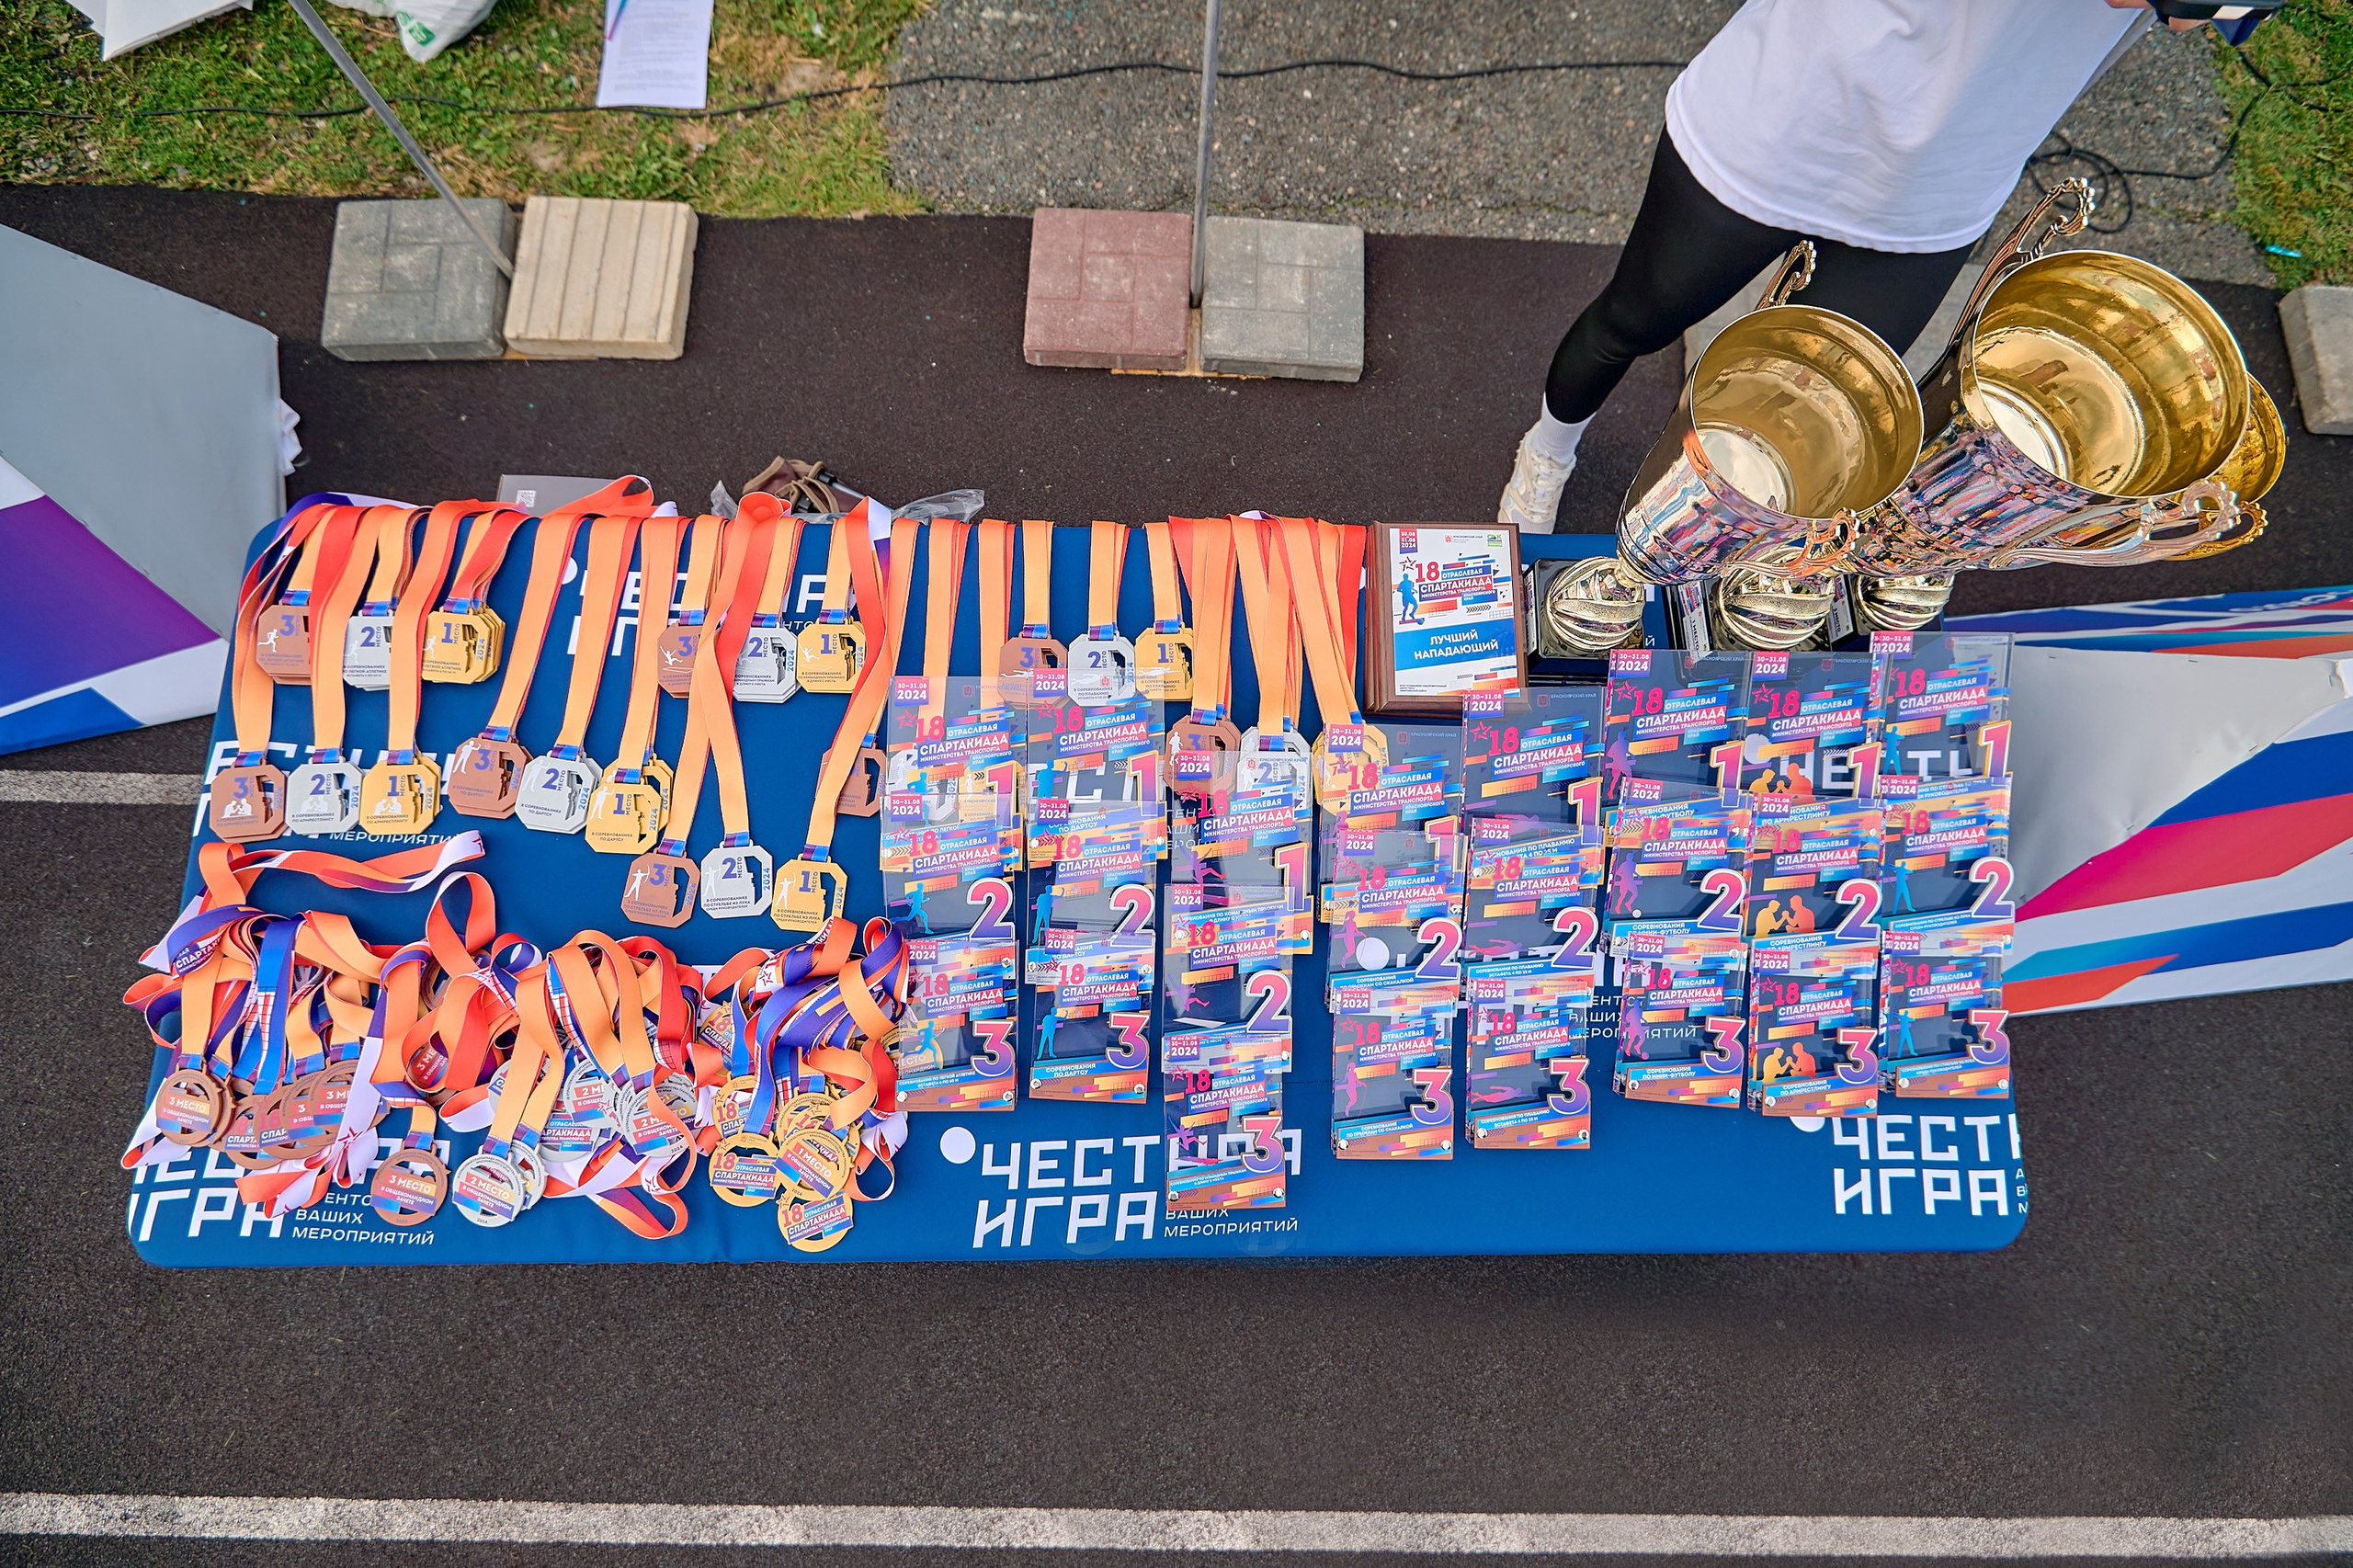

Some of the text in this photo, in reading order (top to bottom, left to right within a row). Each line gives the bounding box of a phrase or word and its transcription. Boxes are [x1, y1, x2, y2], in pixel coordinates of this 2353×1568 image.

[1415, 562, 1483, 583] 18 ОТРАСЛЕВАЯ
[1421, 576, 1492, 593] СПАРТАКИАДА
[442, 623, 451, 642] 1
[1430, 629, 1478, 645] ЛУЧШИЙ
[1414, 639, 1498, 660] НАПАДАЮЩИЙ
[1881, 642, 1910, 653] 2024
[1618, 661, 1648, 671] 2024
[1756, 664, 1786, 674] 2024
[1035, 681, 1064, 690] 2024
[1895, 669, 1976, 697] 18 ОТРАСЛЕВАЯ
[897, 690, 926, 699] 2024
[1631, 687, 1716, 716] 18 ОТРАСЛЕВАЯ
[1768, 690, 1852, 718] 18 ОТРАСЛЕВАЯ
[1900, 687, 1985, 709] СПАРТАКИАДА
[1472, 701, 1501, 711] 2024
[915, 716, 998, 743] 18 ОТРАСЛЕВАЯ
[1053, 706, 1135, 733] 18 ОТРАСЛЕВАЯ
[1636, 708, 1725, 729] СПАРТАКИАДА
[1772, 710, 1860, 731] СПАРТАКИАДА
[920, 733, 1008, 755] СПАРТАКИАДА
[1059, 723, 1146, 745] СПАРТАКИАДА
[1061, 736, 1139, 752] МИНИСТЕРСТВА ТРАНСПОРТА
[1332, 736, 1361, 745] 2024
[1489, 727, 1572, 755] 18 ОТРАСЛЕВАЯ
[474, 749, 491, 770] 3
[1494, 744, 1582, 767] СПАРТАКИАДА
[1981, 722, 2011, 786] 1
[1180, 763, 1211, 772] 2024
[1348, 763, 1432, 790] 18 ОТРАСЛЕВАЯ
[1711, 743, 1743, 808] 1
[1848, 743, 1881, 809] 1
[312, 774, 325, 795] 2
[387, 776, 399, 796] 1
[542, 768, 559, 790] 2
[1129, 751, 1158, 816] 1
[578, 788, 589, 810] 2024
[986, 763, 1015, 826] 1
[1198, 790, 1229, 817] 18
[1232, 798, 1282, 812] ОТРАСЛЕВАЯ
[1353, 782, 1441, 803] СПАРТАКИАДА
[613, 794, 624, 814] 1
[1569, 779, 1601, 845] 1
[649, 808, 657, 831] 2024
[1203, 808, 1293, 830] СПАРТАКИАДА
[1644, 839, 1725, 852] СПАРТАКИАДА
[1906, 828, 1985, 846] СПАРТАКИАДА
[915, 846, 997, 868] СПАРТАКИАДА
[1426, 817, 1456, 884] 1
[1776, 848, 1858, 866] СПАРТАКИАДА
[722, 858, 735, 879] 2
[1058, 854, 1142, 872] СПАРТАКИАДА
[800, 871, 811, 892] 1
[1275, 845, 1307, 911] 1
[1496, 876, 1578, 892] СПАРТАКИАДА
[1970, 858, 2014, 917] 2
[835, 887, 844, 910] 2024
[1362, 886, 1444, 903] СПАРТАКИАДА
[1700, 869, 1746, 932] 2
[967, 878, 1014, 940] 2
[1110, 884, 1155, 948] 2
[1836, 879, 1881, 940] 2
[1192, 938, 1275, 959] СПАРТАКИАДА
[1416, 917, 1463, 979] 2
[1552, 907, 1598, 968] 2
[927, 990, 1003, 1007] СПАРТАКИАДА
[1063, 983, 1137, 997] СПАРТАКИАДА
[1650, 986, 1722, 999] СПАРТАКИАДА
[1909, 981, 1981, 997] СПАРТАКИАДА
[1246, 970, 1291, 1033] 2
[1779, 999, 1852, 1015] СПАРТАКИАДА
[1106, 1013, 1150, 1069] 3
[1359, 1037, 1433, 1055] СПАРТАКИАДА
[1495, 1028, 1568, 1046] СПАРТАКИАДА
[1702, 1017, 1745, 1074] 3
[1969, 1009, 2010, 1064] 3
[972, 1020, 1015, 1077] 3
[1836, 1028, 1878, 1084] 3
[1045, 1062, 1097, 1074] СОРЕВНОВАНИЯ
[1190, 1082, 1265, 1105] СПАРТАКИАДА
[1547, 1058, 1590, 1114] 3
[1782, 1080, 1827, 1090] СОРЕВНОВАНИЯ
[1790, 1084, 1831, 1095] АРМРЕСТЛИНГУ
[1410, 1068, 1453, 1125] 3
[1241, 1116, 1286, 1174] 3
[713, 1153, 770, 1172] 18 ОТРАСЛЕВАЯ
[790, 1156, 831, 1190] ОБЩЕКОМАНДНОМ
[798, 1148, 833, 1178] 1 МЕСТО
[390, 1175, 431, 1193] 3 МЕСТО
[714, 1171, 774, 1182] СПАРТАКИАДА
[386, 1187, 434, 1205] ОБЩЕКОМАНДНОМ
[468, 1187, 512, 1211] ОБЩЕКОМАНДНОМ
[471, 1176, 510, 1200] 2 МЕСТО
[1834, 1168, 2009, 1215] ИГРА
[295, 1209, 364, 1224] ВАШИХ
[972, 1191, 1158, 1248] ИГРА
[1164, 1217, 1299, 1237] МЕРОПРИЯТИЙ
[292, 1226, 435, 1245] МЕРОПРИЯТИЙ
